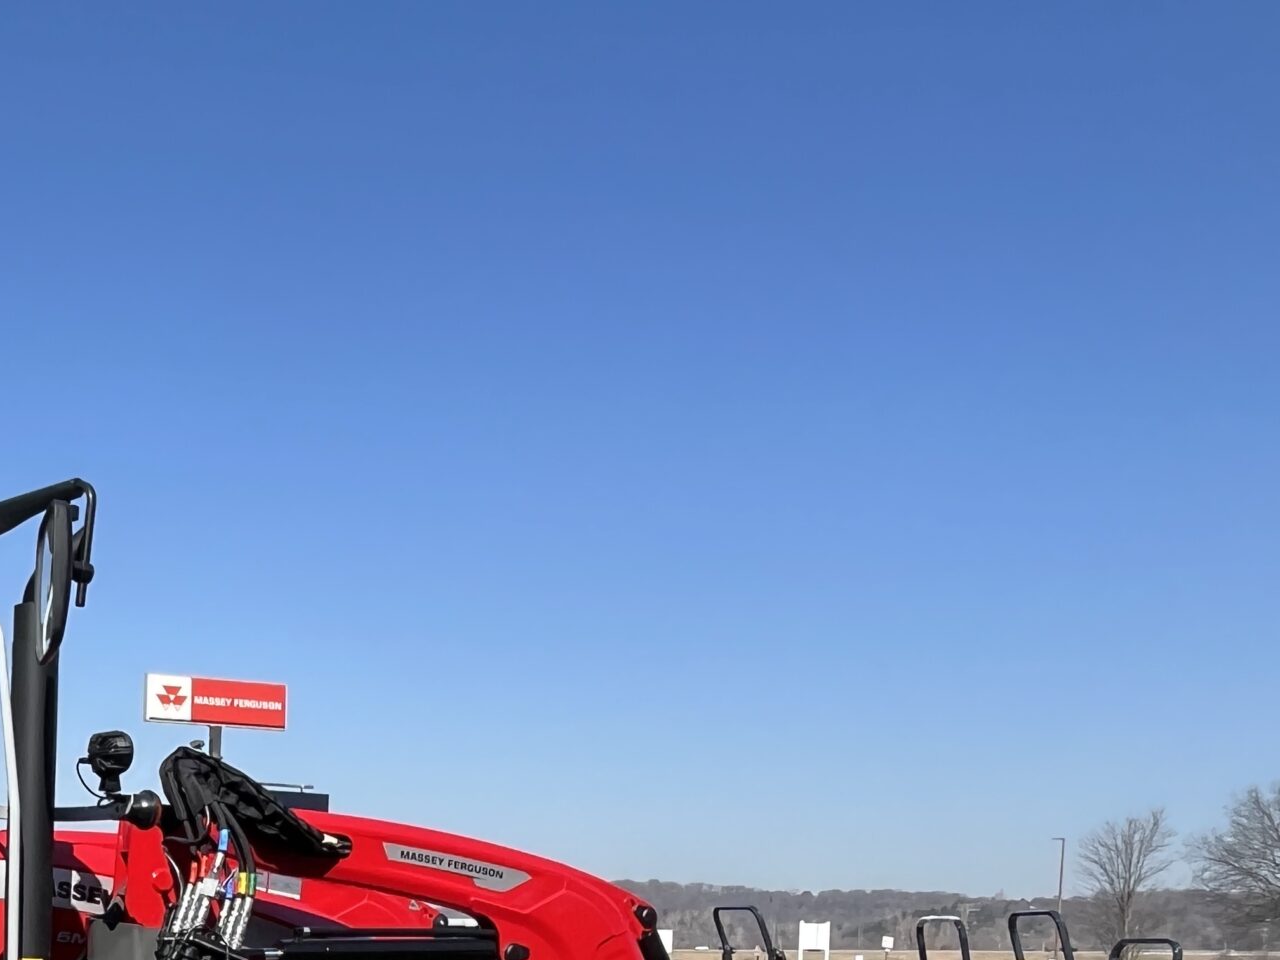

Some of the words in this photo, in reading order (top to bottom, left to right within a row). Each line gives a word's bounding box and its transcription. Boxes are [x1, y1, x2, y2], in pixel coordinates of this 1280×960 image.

[193, 695, 232, 707] MASSEY
[233, 698, 282, 711] FERGUSON
[400, 850, 445, 866] MASSEY
[447, 859, 504, 879] FERGUSON
